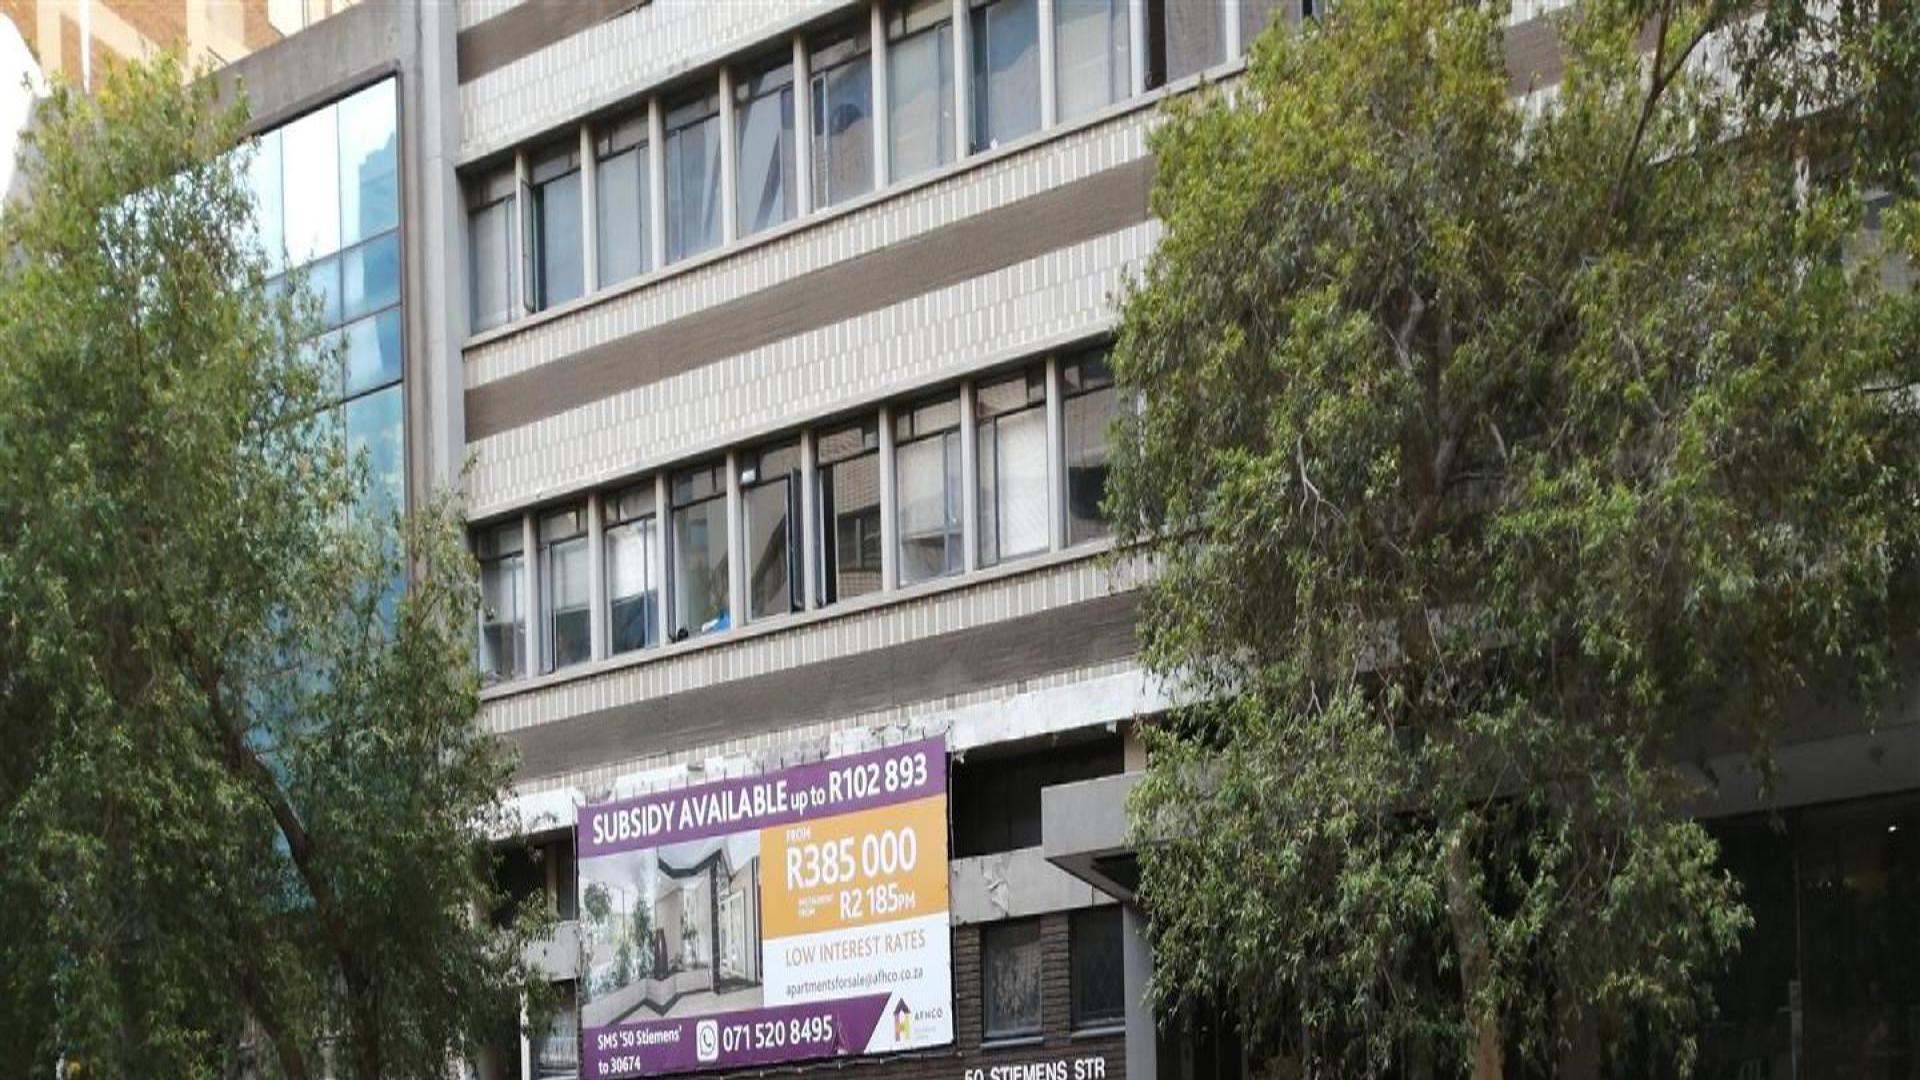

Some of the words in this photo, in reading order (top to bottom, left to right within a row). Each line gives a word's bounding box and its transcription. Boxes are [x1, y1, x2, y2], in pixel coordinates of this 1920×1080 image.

[593, 801, 675, 844] SUBSIDY
[679, 780, 788, 831] AVAILABLE
[790, 790, 808, 815] up
[811, 785, 826, 807] to
[828, 763, 881, 803] R102
[884, 752, 928, 792] 893
[786, 836, 856, 891] R385
[861, 827, 917, 878] 000
[839, 887, 864, 920] R2
[785, 944, 816, 968] LOW
[819, 936, 881, 962] INTEREST
[884, 929, 926, 954] RATES
[785, 966, 924, 998] apartmentsforsale@afhco.co.za
[597, 1032, 619, 1050] SMS
[722, 1026, 751, 1052] 071
[755, 1020, 786, 1050] 520
[789, 1014, 834, 1046] 8495
[598, 1060, 610, 1076] to
[611, 1056, 642, 1073] 30674
[1074, 1056, 1106, 1080] STR
